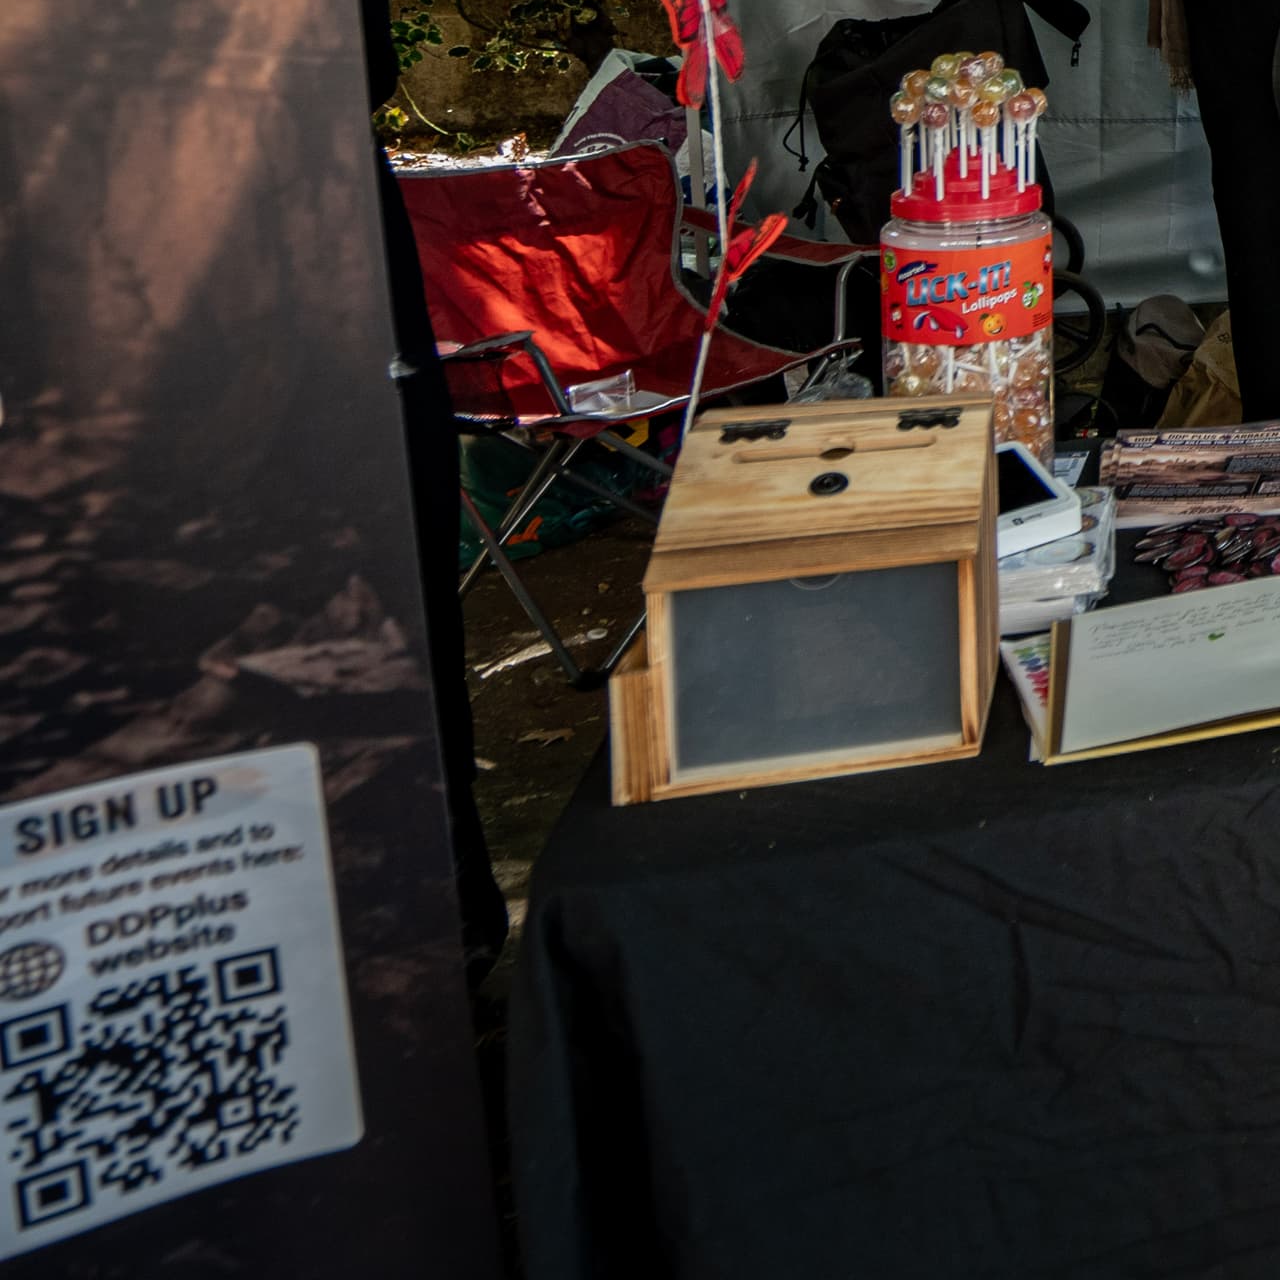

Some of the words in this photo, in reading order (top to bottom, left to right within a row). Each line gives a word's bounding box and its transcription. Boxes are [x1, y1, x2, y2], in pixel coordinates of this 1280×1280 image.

[906, 260, 1012, 307] LICK-IT!
[962, 287, 1018, 314] Lollipops
[1191, 431, 1217, 440] PLUS
[16, 793, 138, 857] SIGN
[157, 776, 219, 820] UP
[19, 863, 94, 898] more
[101, 840, 190, 878] details
[194, 825, 244, 853] and
[250, 822, 275, 843] to
[59, 878, 144, 916] future
[150, 856, 238, 891] events
[86, 888, 251, 949] DDPplus
[86, 922, 238, 977] website
